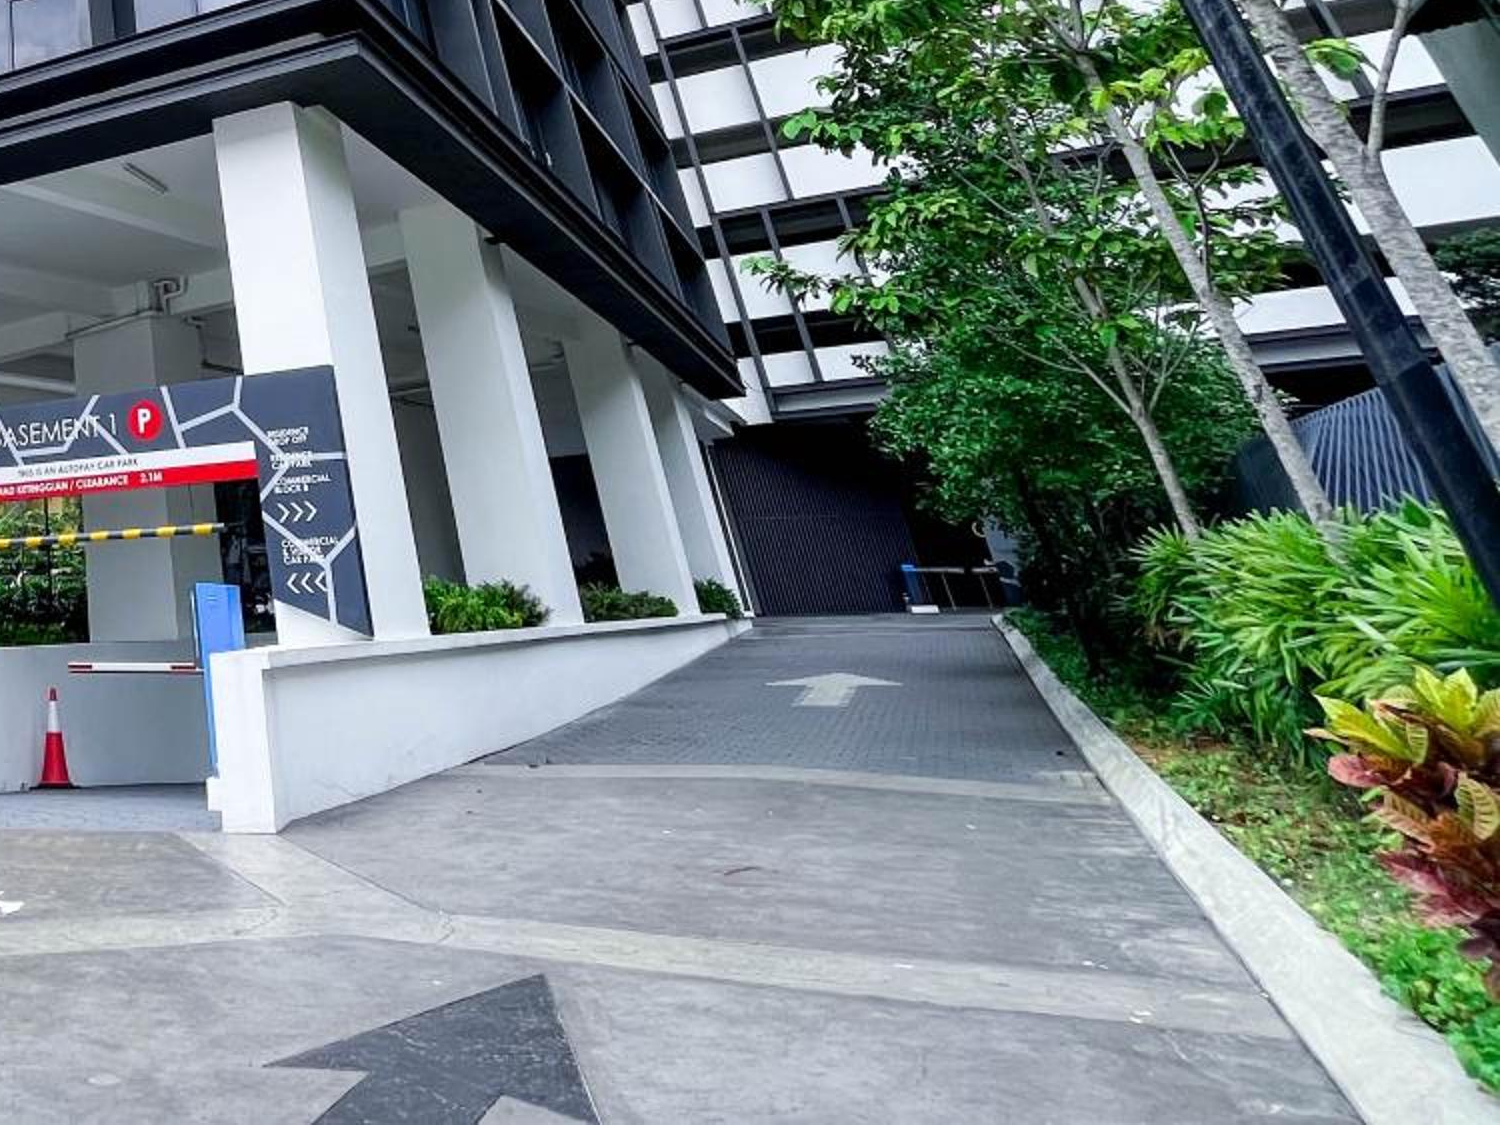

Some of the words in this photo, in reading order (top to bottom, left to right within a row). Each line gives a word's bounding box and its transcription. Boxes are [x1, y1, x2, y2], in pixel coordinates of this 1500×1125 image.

[110, 413, 117, 435] 1
[137, 408, 151, 433] P
[98, 460, 115, 470] CAR
[117, 458, 139, 468] PARK
[75, 474, 128, 489] CLEARANCE
